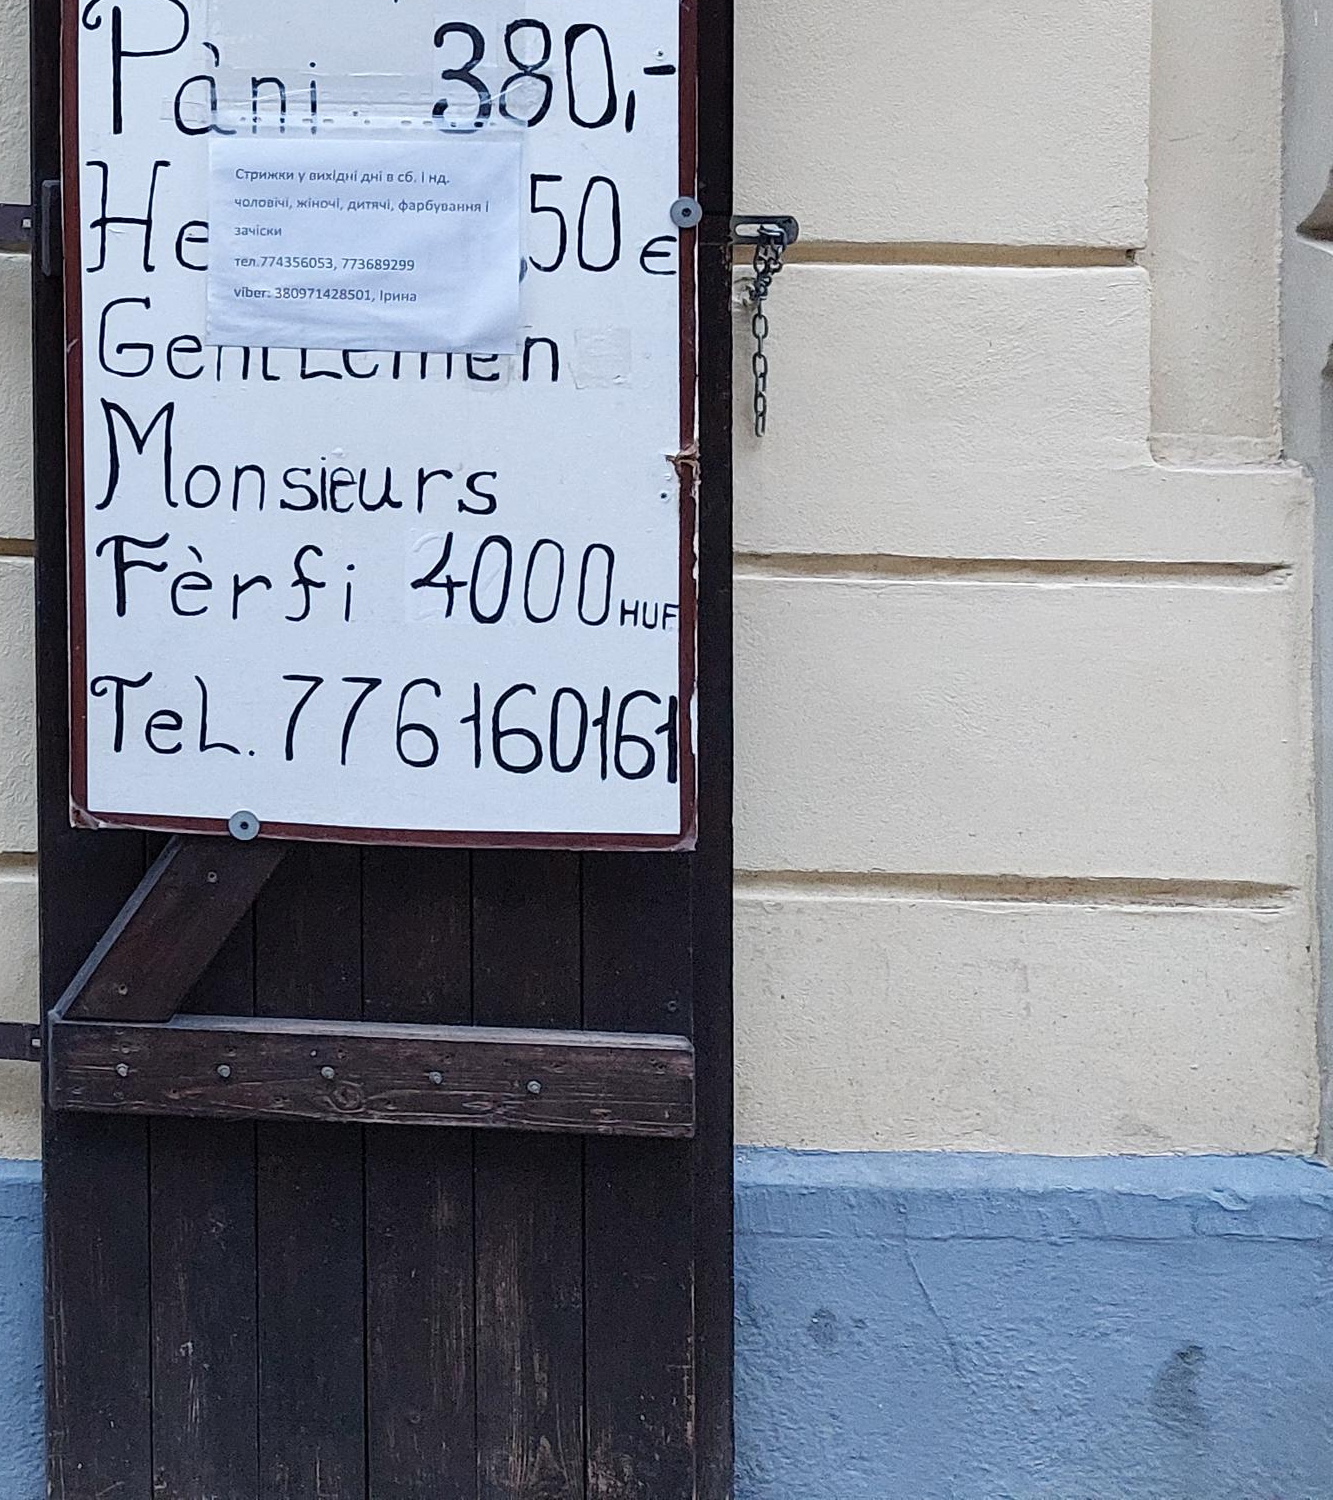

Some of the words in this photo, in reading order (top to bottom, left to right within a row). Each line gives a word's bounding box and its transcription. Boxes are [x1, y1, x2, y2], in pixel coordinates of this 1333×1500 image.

[235, 168, 294, 182] Стрижки
[298, 171, 306, 183] у
[360, 170, 382, 184] дні
[386, 173, 394, 183] в
[397, 170, 417, 183] сб.
[428, 174, 450, 186] нд.
[234, 196, 293, 209] чоловічі,
[296, 197, 343, 211] жіночі,
[347, 198, 394, 212] дитячі,
[398, 199, 482, 214] фарбування
[234, 224, 282, 237] зачіски
[342, 257, 415, 271] 773689299
[275, 287, 376, 303] 380971428501,
[379, 289, 417, 304] Ірина
[95, 398, 496, 515] Monsieurs
[411, 532, 614, 626] 4000
[620, 598, 681, 632] HUF
[283, 675, 677, 783] 776160161
